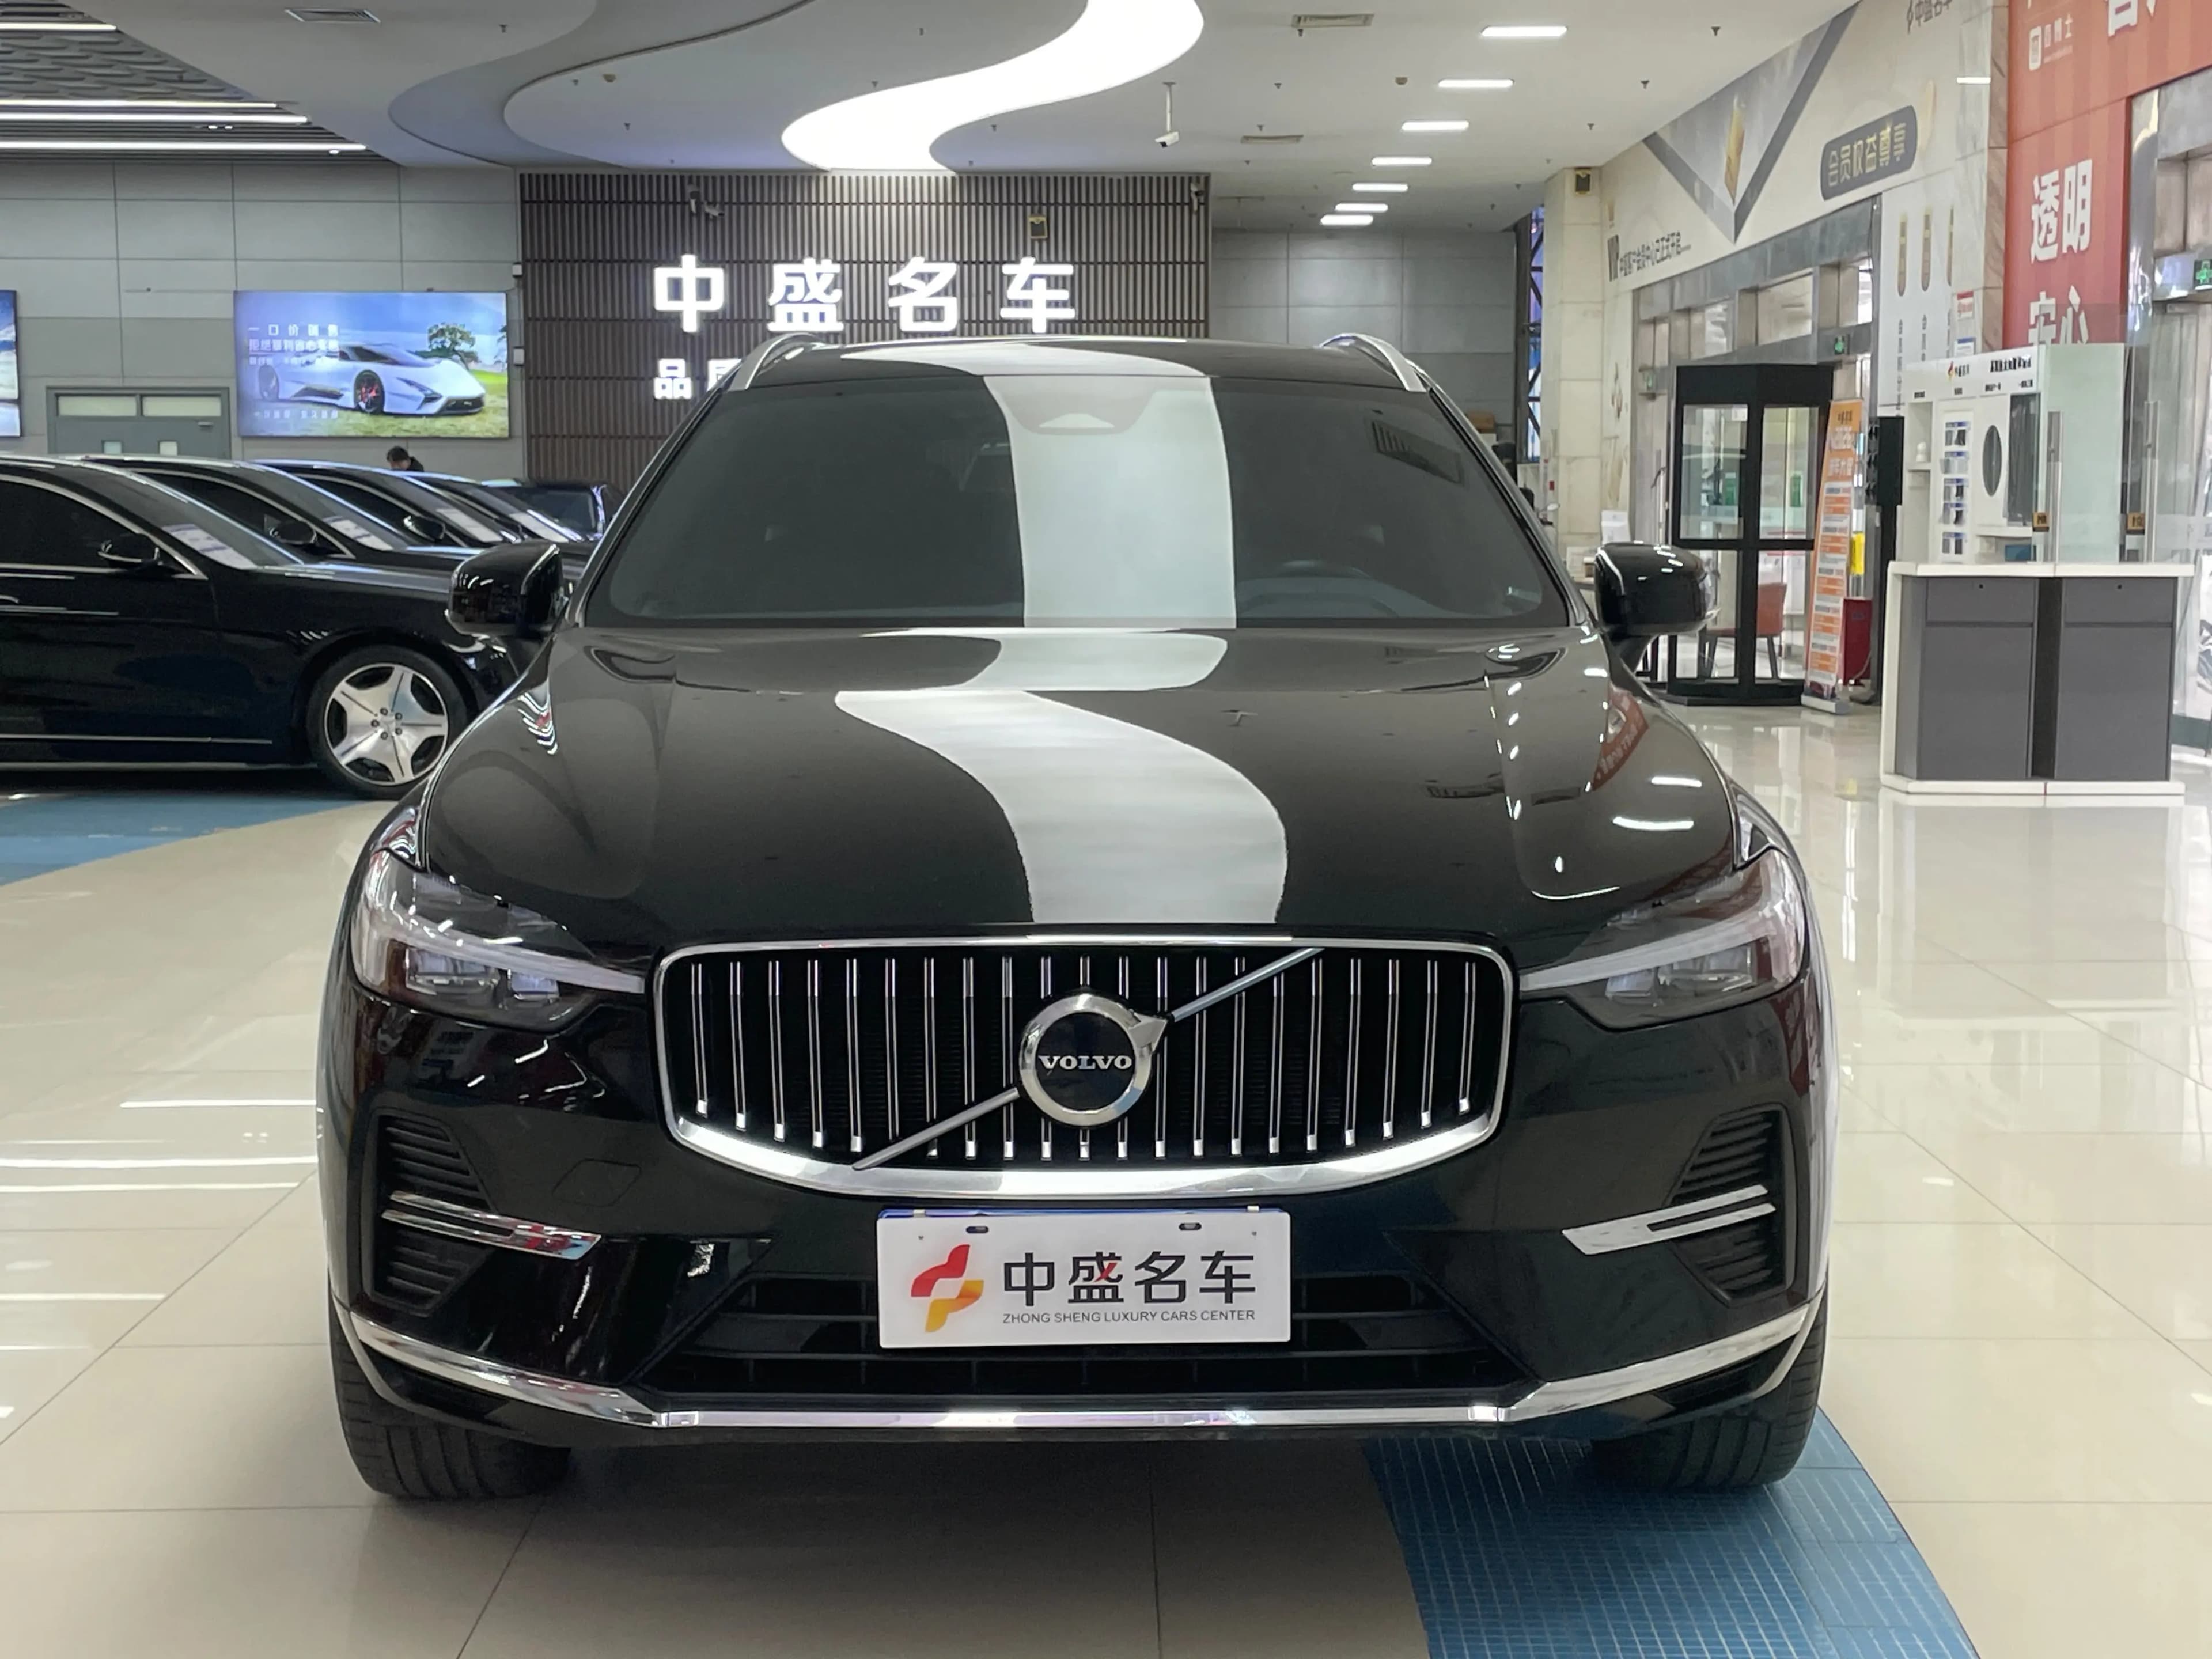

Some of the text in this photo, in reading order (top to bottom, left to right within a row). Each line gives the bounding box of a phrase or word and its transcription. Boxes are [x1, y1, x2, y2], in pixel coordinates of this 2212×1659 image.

[1828, 123, 1906, 187] 会员权益尊享
[2030, 159, 2092, 264] 透明
[653, 255, 1076, 333] 中盛名车
[2027, 285, 2089, 346] 安心
[1038, 1054, 1133, 1070] VOLVO
[1003, 1250, 1256, 1307] 中盛名车
[1003, 1309, 1256, 1324] ZHONG SHENG LUXURY CARS CENTER
